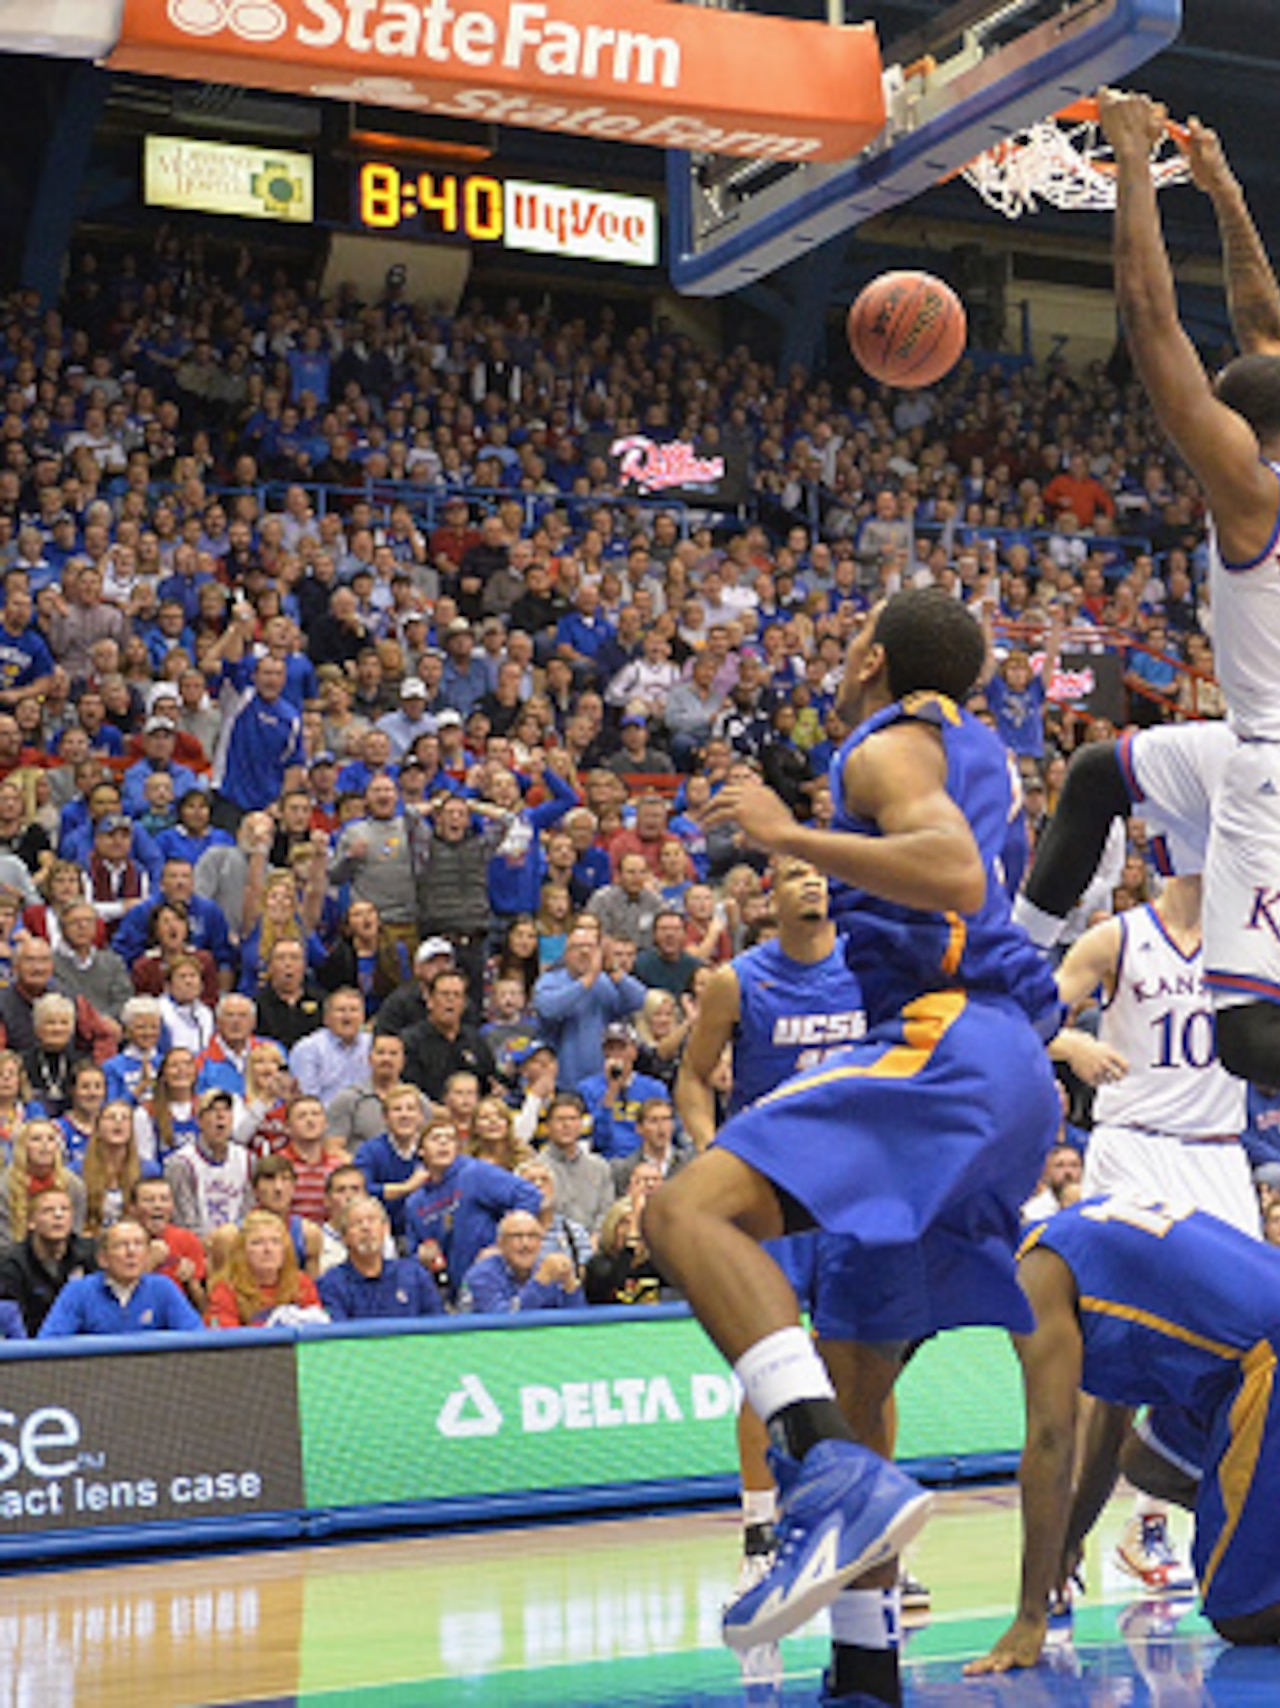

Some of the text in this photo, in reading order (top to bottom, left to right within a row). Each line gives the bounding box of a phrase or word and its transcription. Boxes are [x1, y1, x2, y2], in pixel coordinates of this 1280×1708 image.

[360, 161, 504, 241] 8:40
[1150, 1007, 1218, 1070] 10
[518, 1375, 685, 1433] DELTA
[75, 1477, 158, 1512] lens
[170, 1471, 262, 1503] case
